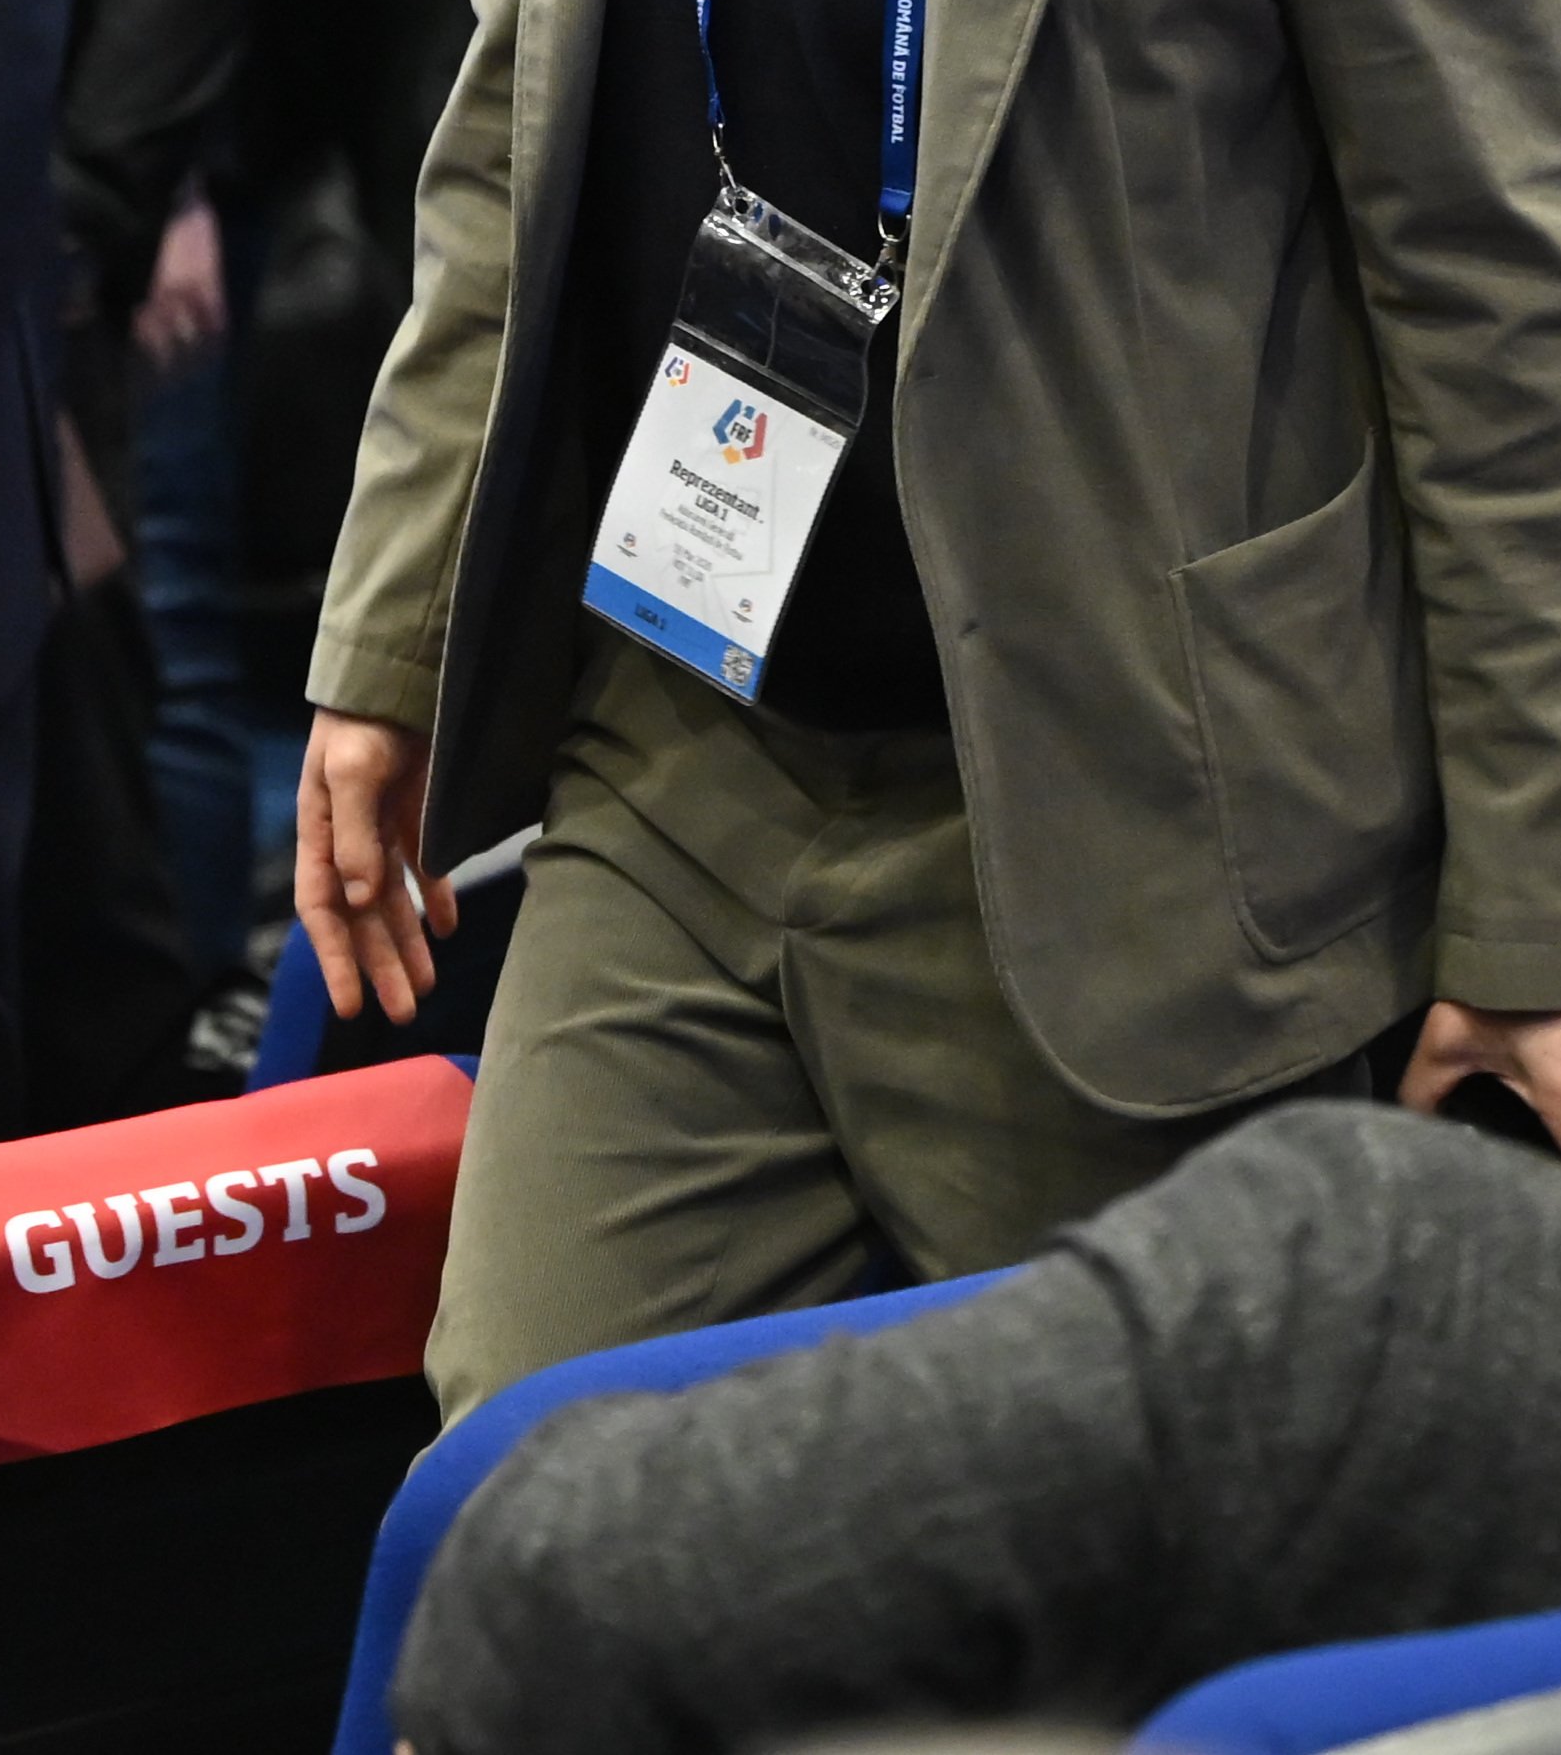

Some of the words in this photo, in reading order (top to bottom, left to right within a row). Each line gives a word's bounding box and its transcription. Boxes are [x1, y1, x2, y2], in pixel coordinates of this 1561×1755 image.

[891, 59, 907, 82] DE
[890, 83, 907, 144] FOTBAL
[729, 421, 754, 444] FRF
[3, 1147, 387, 1294] GUESTS
